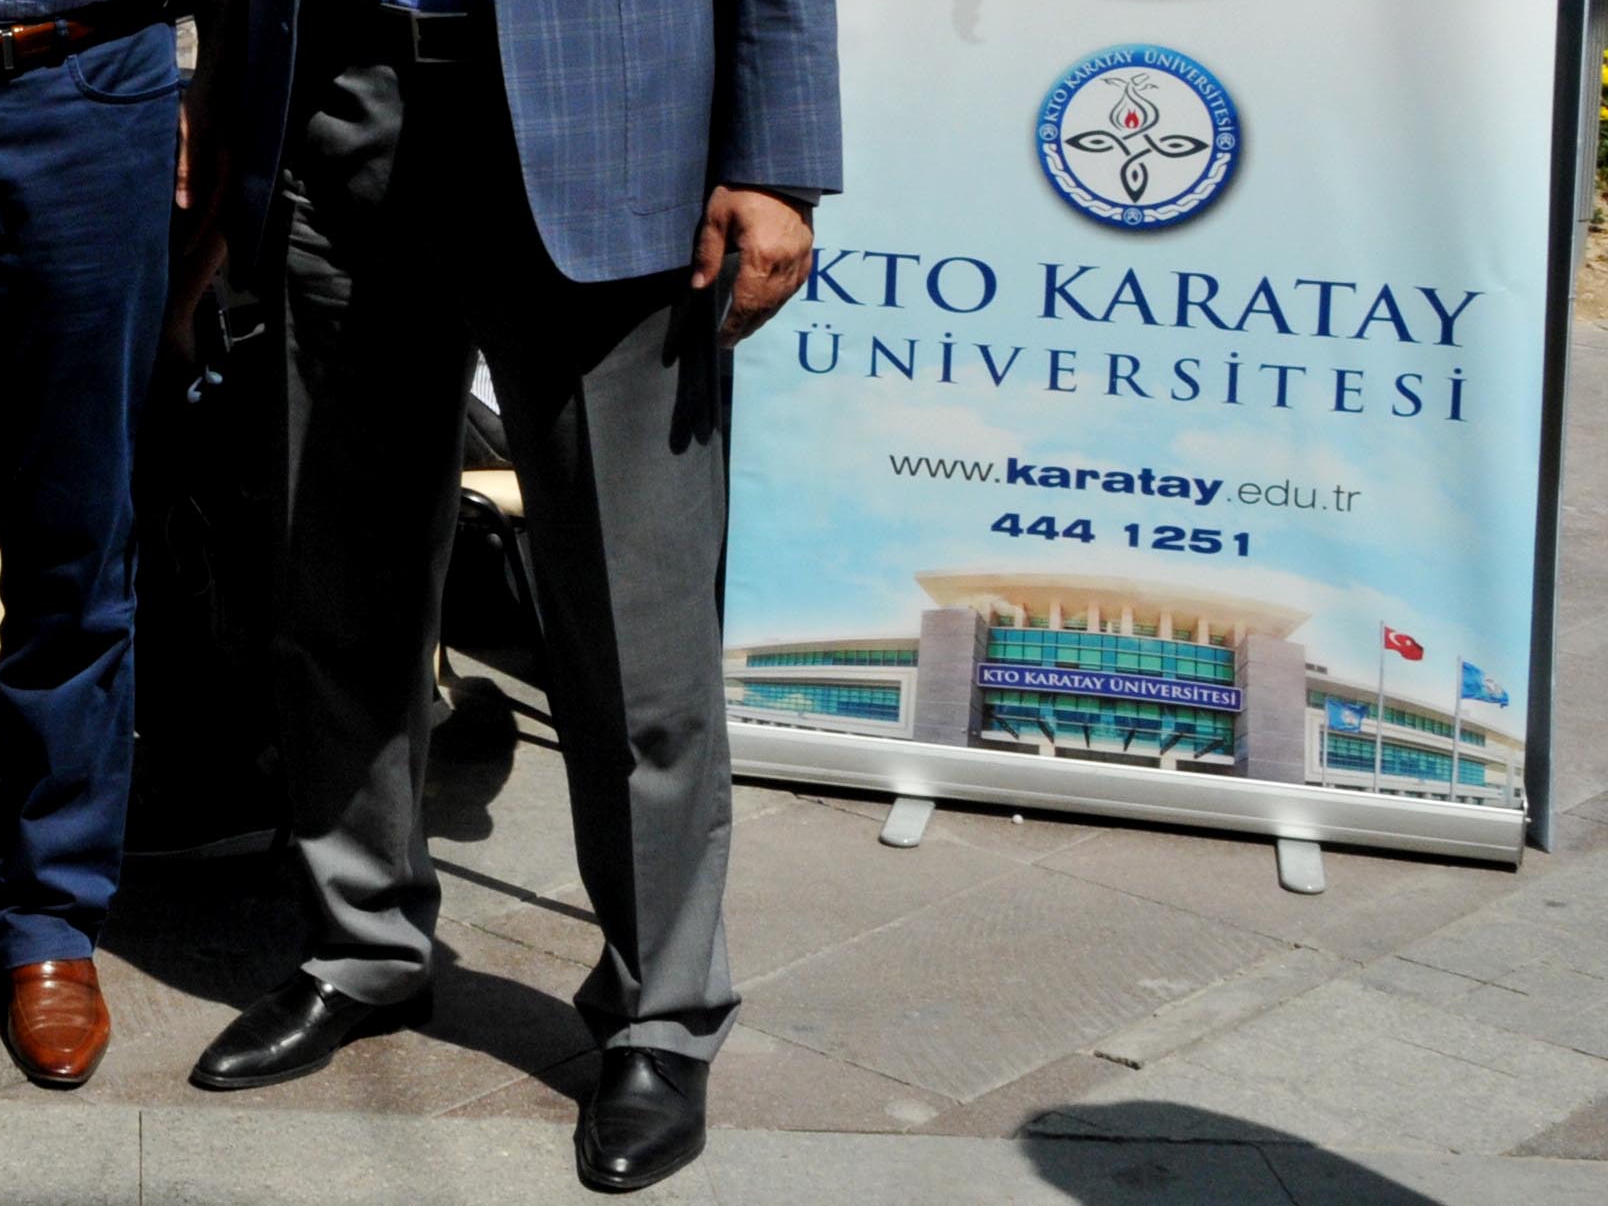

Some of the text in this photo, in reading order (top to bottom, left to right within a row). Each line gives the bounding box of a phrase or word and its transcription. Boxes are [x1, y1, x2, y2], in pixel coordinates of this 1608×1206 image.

[1044, 50, 1235, 132] KTO KARATAY ÜNİVERSİTESİ
[801, 247, 1485, 347] KTO KARATAY
[793, 323, 1467, 421] ÜNİVERSİTESİ
[889, 454, 1362, 512] www.karatay.edu.tr
[990, 512, 1251, 557] 444 1251
[983, 669, 1237, 706] KTO KARATAY ÜNİVERSİTESİ
